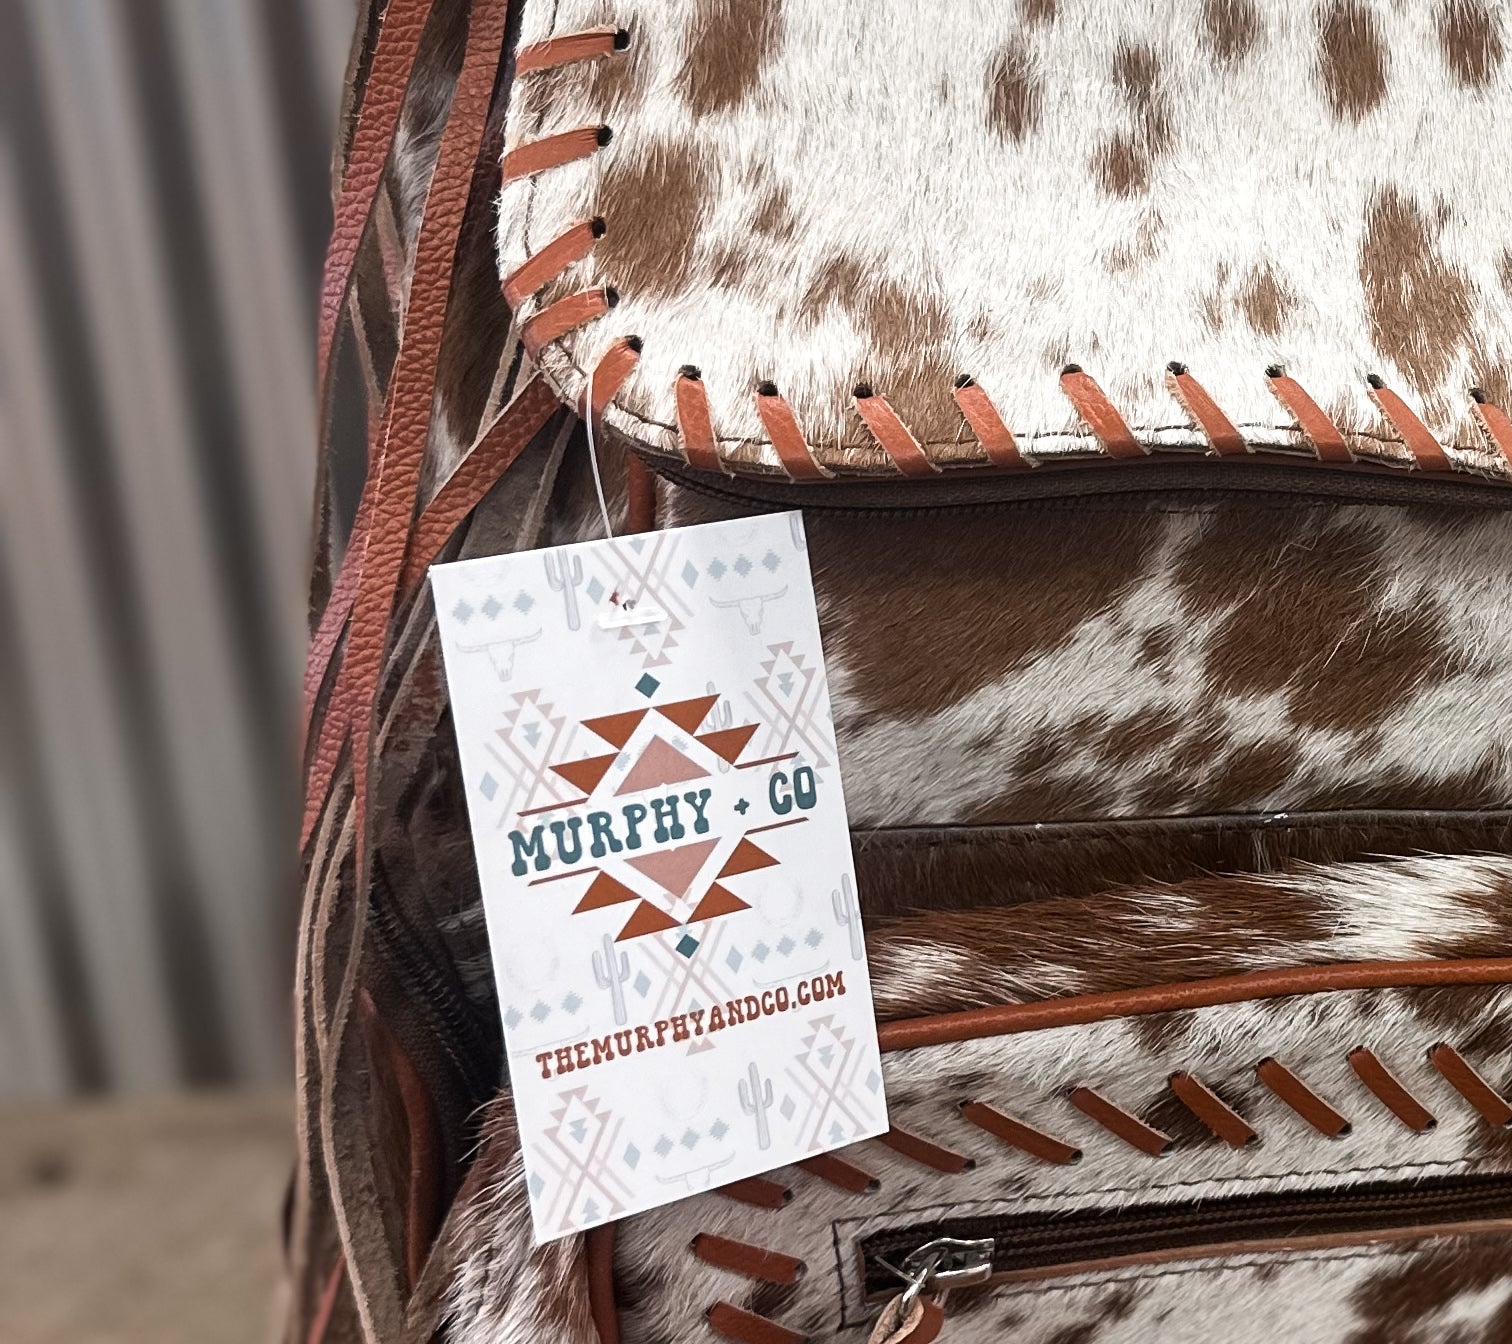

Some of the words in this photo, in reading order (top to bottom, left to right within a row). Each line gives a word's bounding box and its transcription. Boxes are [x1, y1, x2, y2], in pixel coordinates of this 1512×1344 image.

[508, 788, 712, 876] MURPHY
[768, 766, 817, 816] CO
[536, 971, 846, 1079] THEMURPHYANDCO.COM
